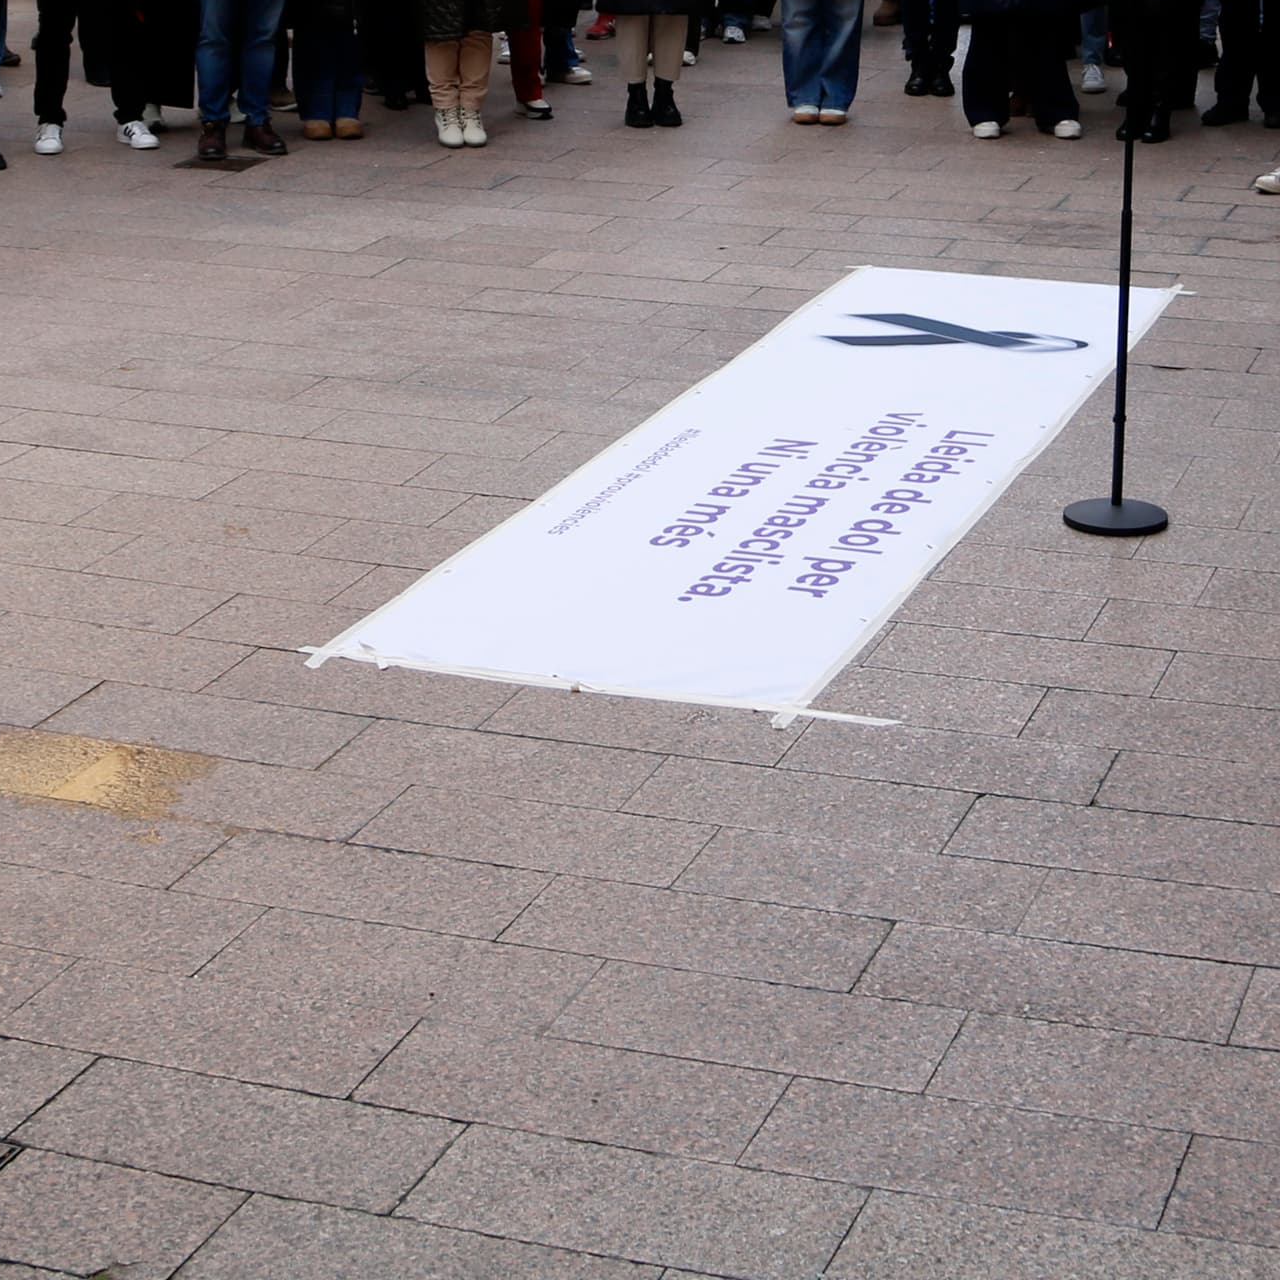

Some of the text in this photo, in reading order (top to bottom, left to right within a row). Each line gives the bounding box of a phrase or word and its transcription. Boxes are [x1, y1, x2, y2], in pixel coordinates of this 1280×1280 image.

[649, 438, 819, 548] Ni una més
[677, 412, 928, 602] violència masclista.
[787, 430, 995, 599] Lleida de dol per
